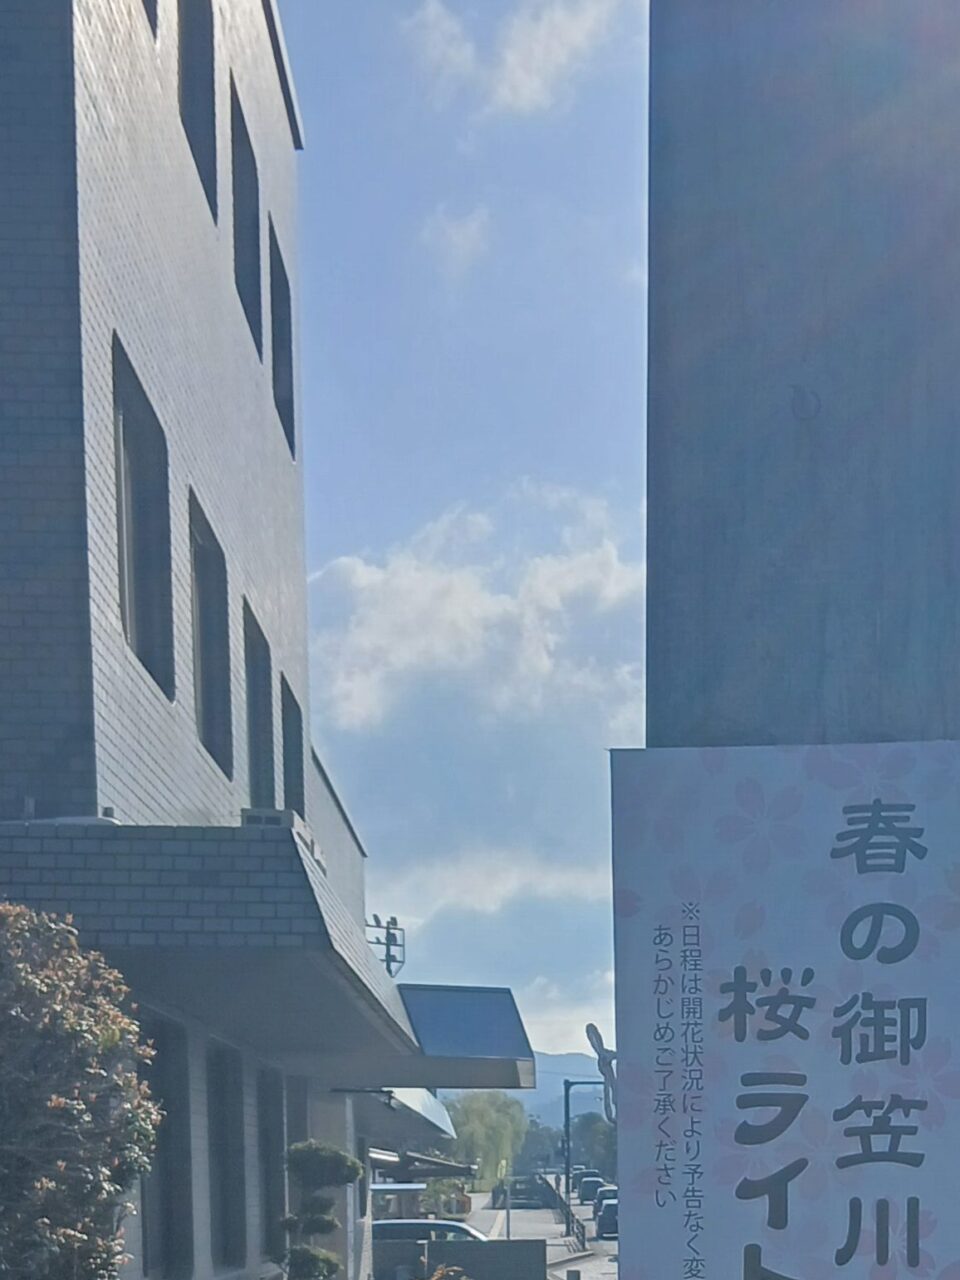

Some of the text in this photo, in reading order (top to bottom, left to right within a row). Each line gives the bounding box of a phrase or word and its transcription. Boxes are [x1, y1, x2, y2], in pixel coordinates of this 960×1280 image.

[652, 924, 677, 1208] あらかじめご了承ください
